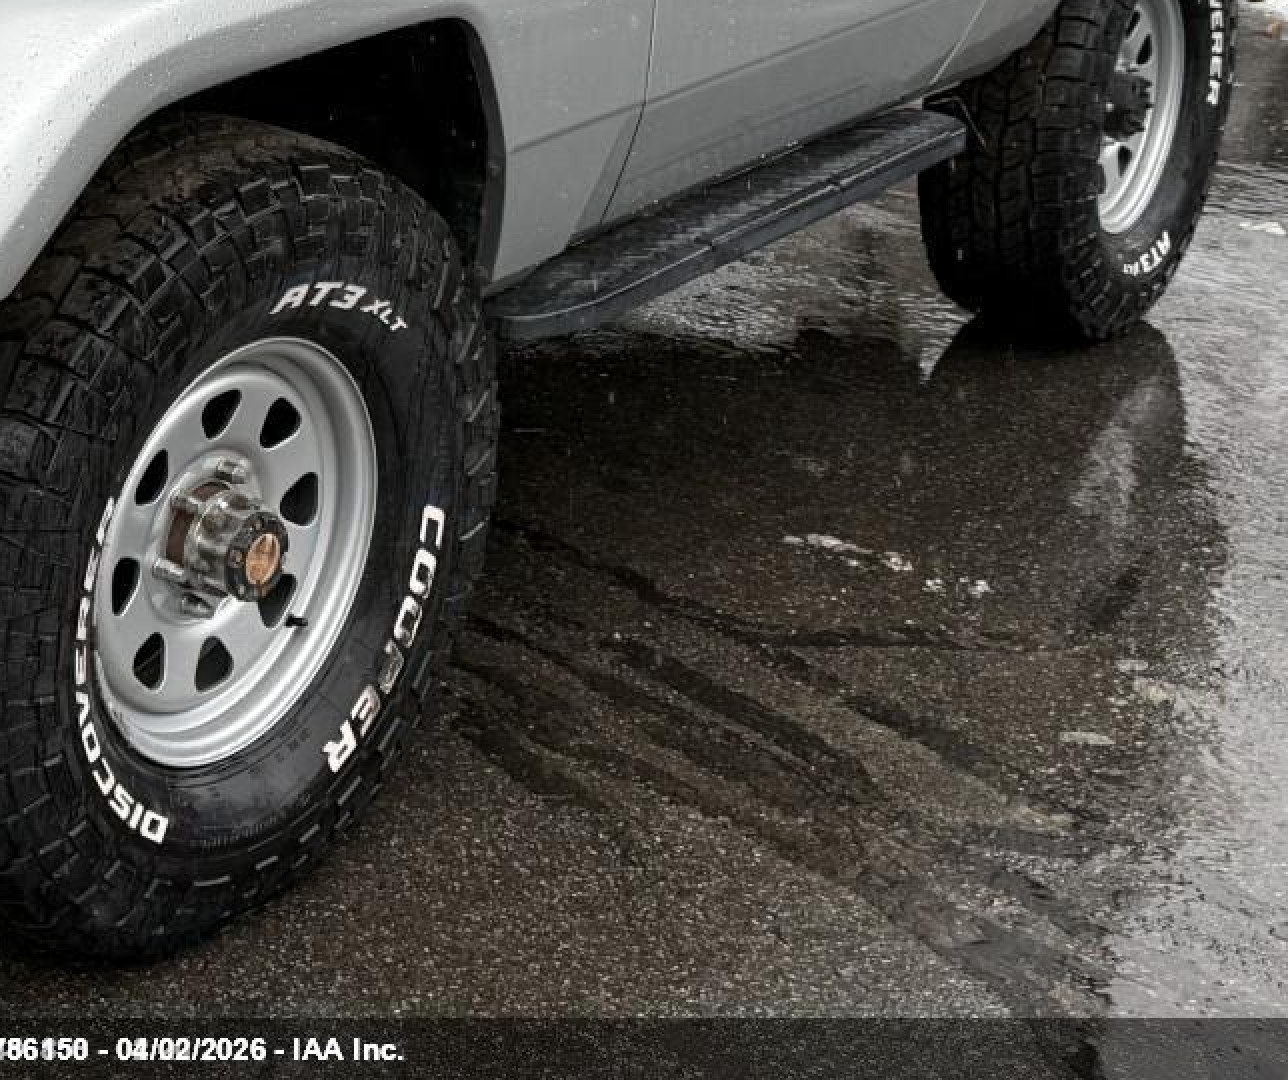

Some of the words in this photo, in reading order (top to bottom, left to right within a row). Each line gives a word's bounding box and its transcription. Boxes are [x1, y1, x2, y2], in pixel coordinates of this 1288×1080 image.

[269, 282, 368, 315] AT3
[360, 298, 409, 332] XLT
[75, 496, 169, 845] DISCOVERER
[322, 504, 446, 774] COOPER
